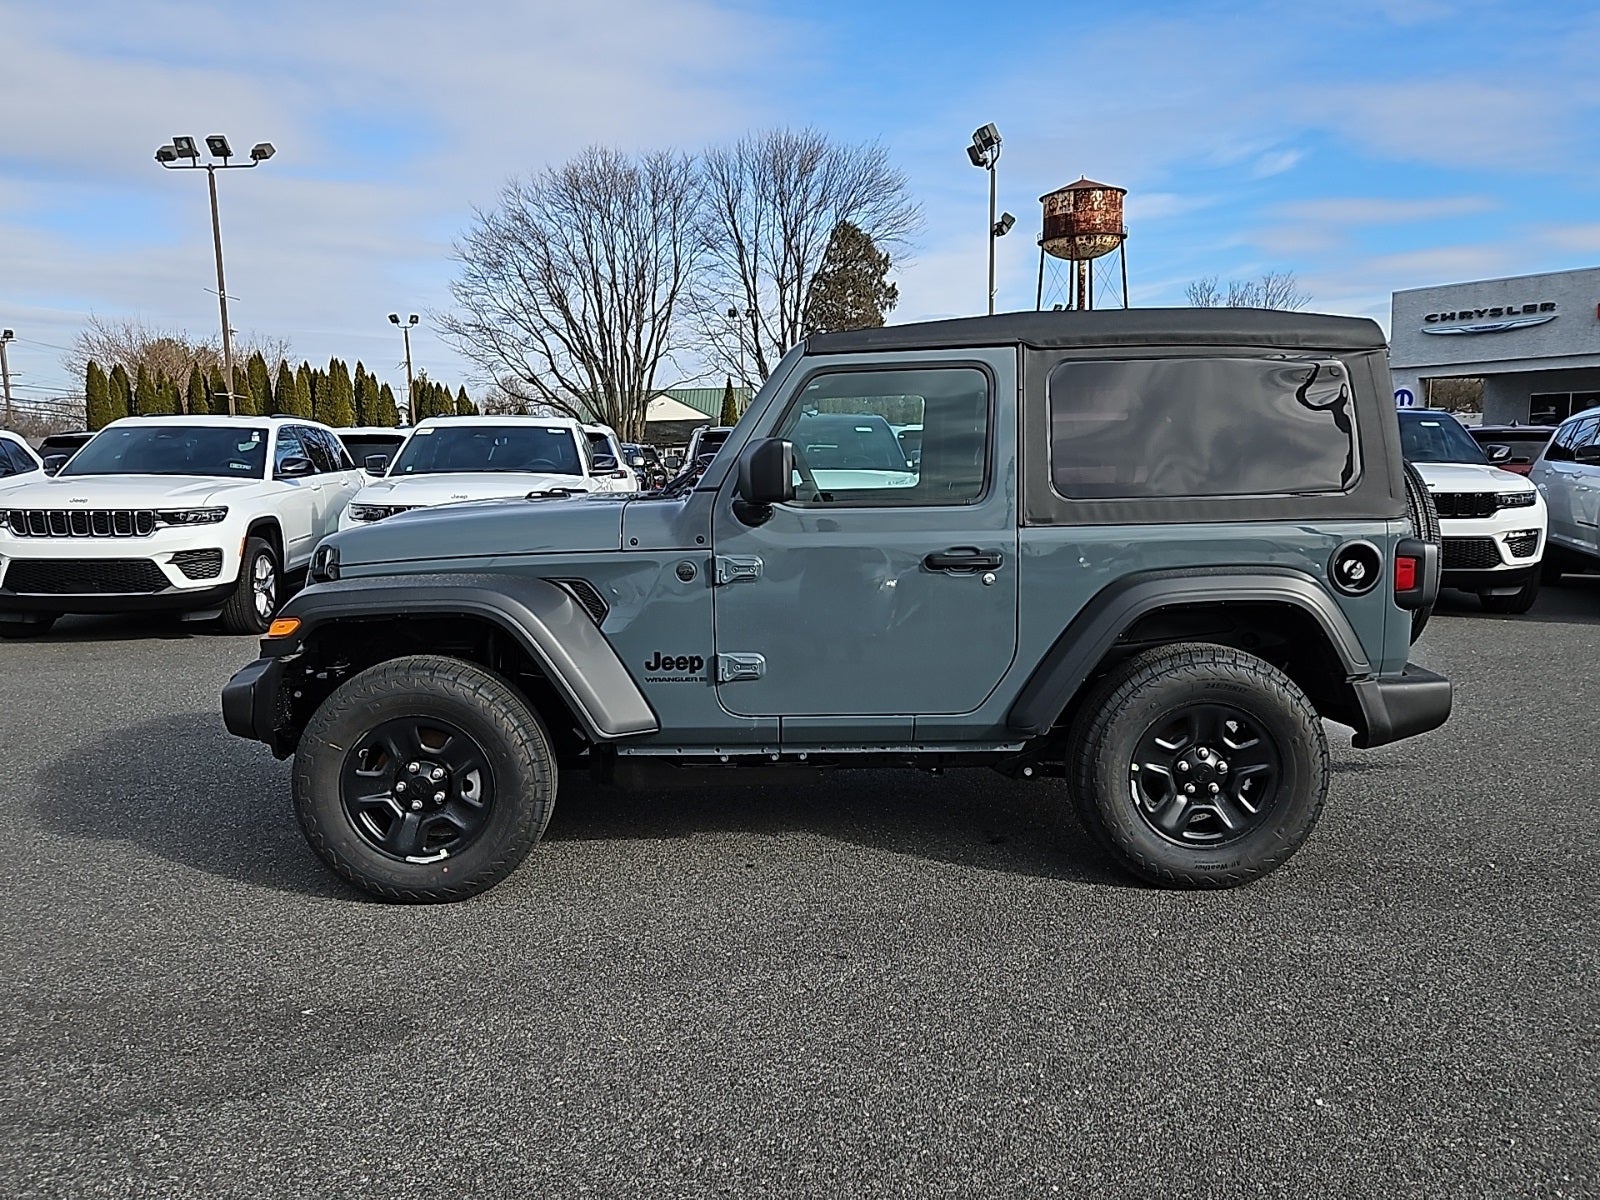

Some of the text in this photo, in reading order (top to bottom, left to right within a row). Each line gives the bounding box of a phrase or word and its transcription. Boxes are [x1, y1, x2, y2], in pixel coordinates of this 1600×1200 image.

[1424, 302, 1556, 323] CHRYSLER
[645, 652, 704, 674] Jeep
[1194, 863, 1228, 871] Weather
